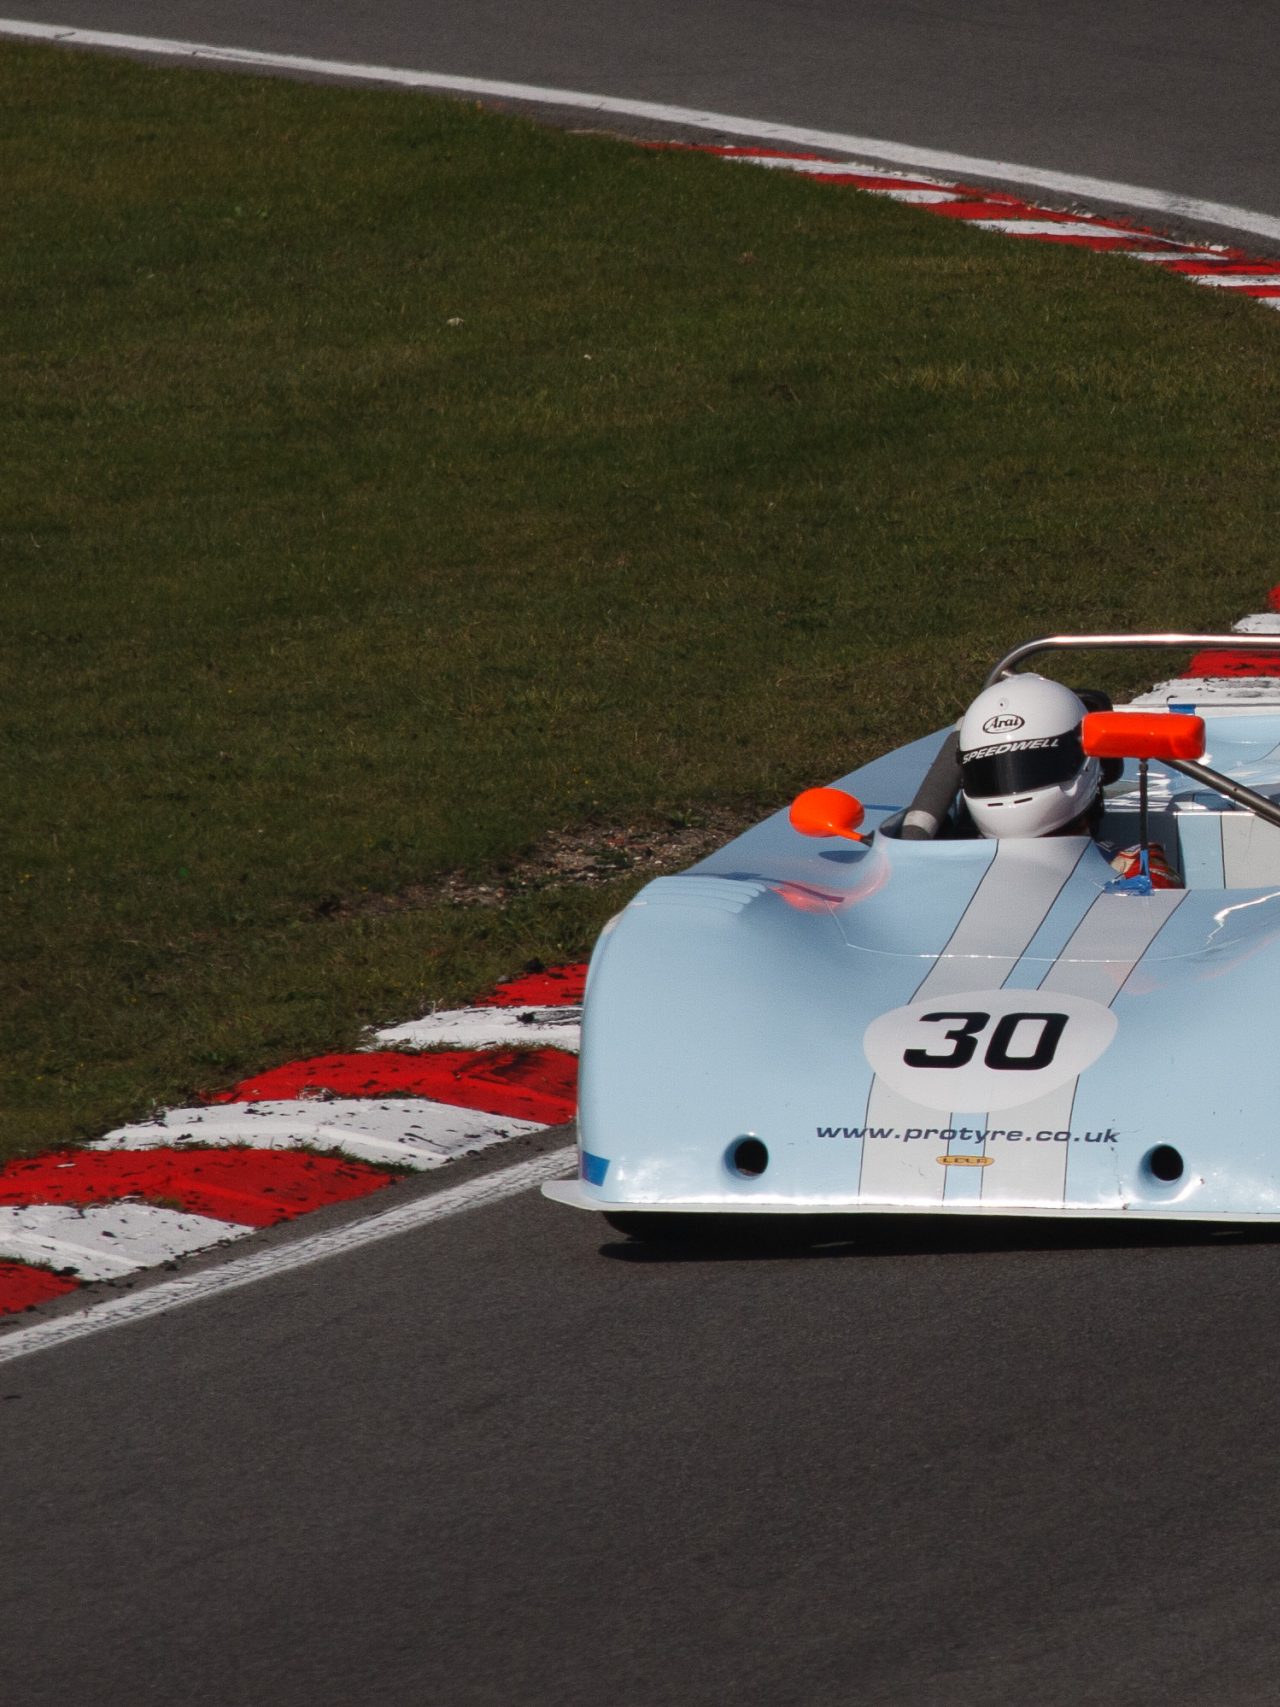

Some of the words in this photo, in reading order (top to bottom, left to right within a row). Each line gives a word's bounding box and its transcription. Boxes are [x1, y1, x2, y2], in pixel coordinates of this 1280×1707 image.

[989, 717, 1018, 728] Arai
[961, 738, 1059, 764] SPEEDWELL
[903, 1011, 1070, 1071] 30
[815, 1126, 1121, 1145] www.protyre.co.uk
